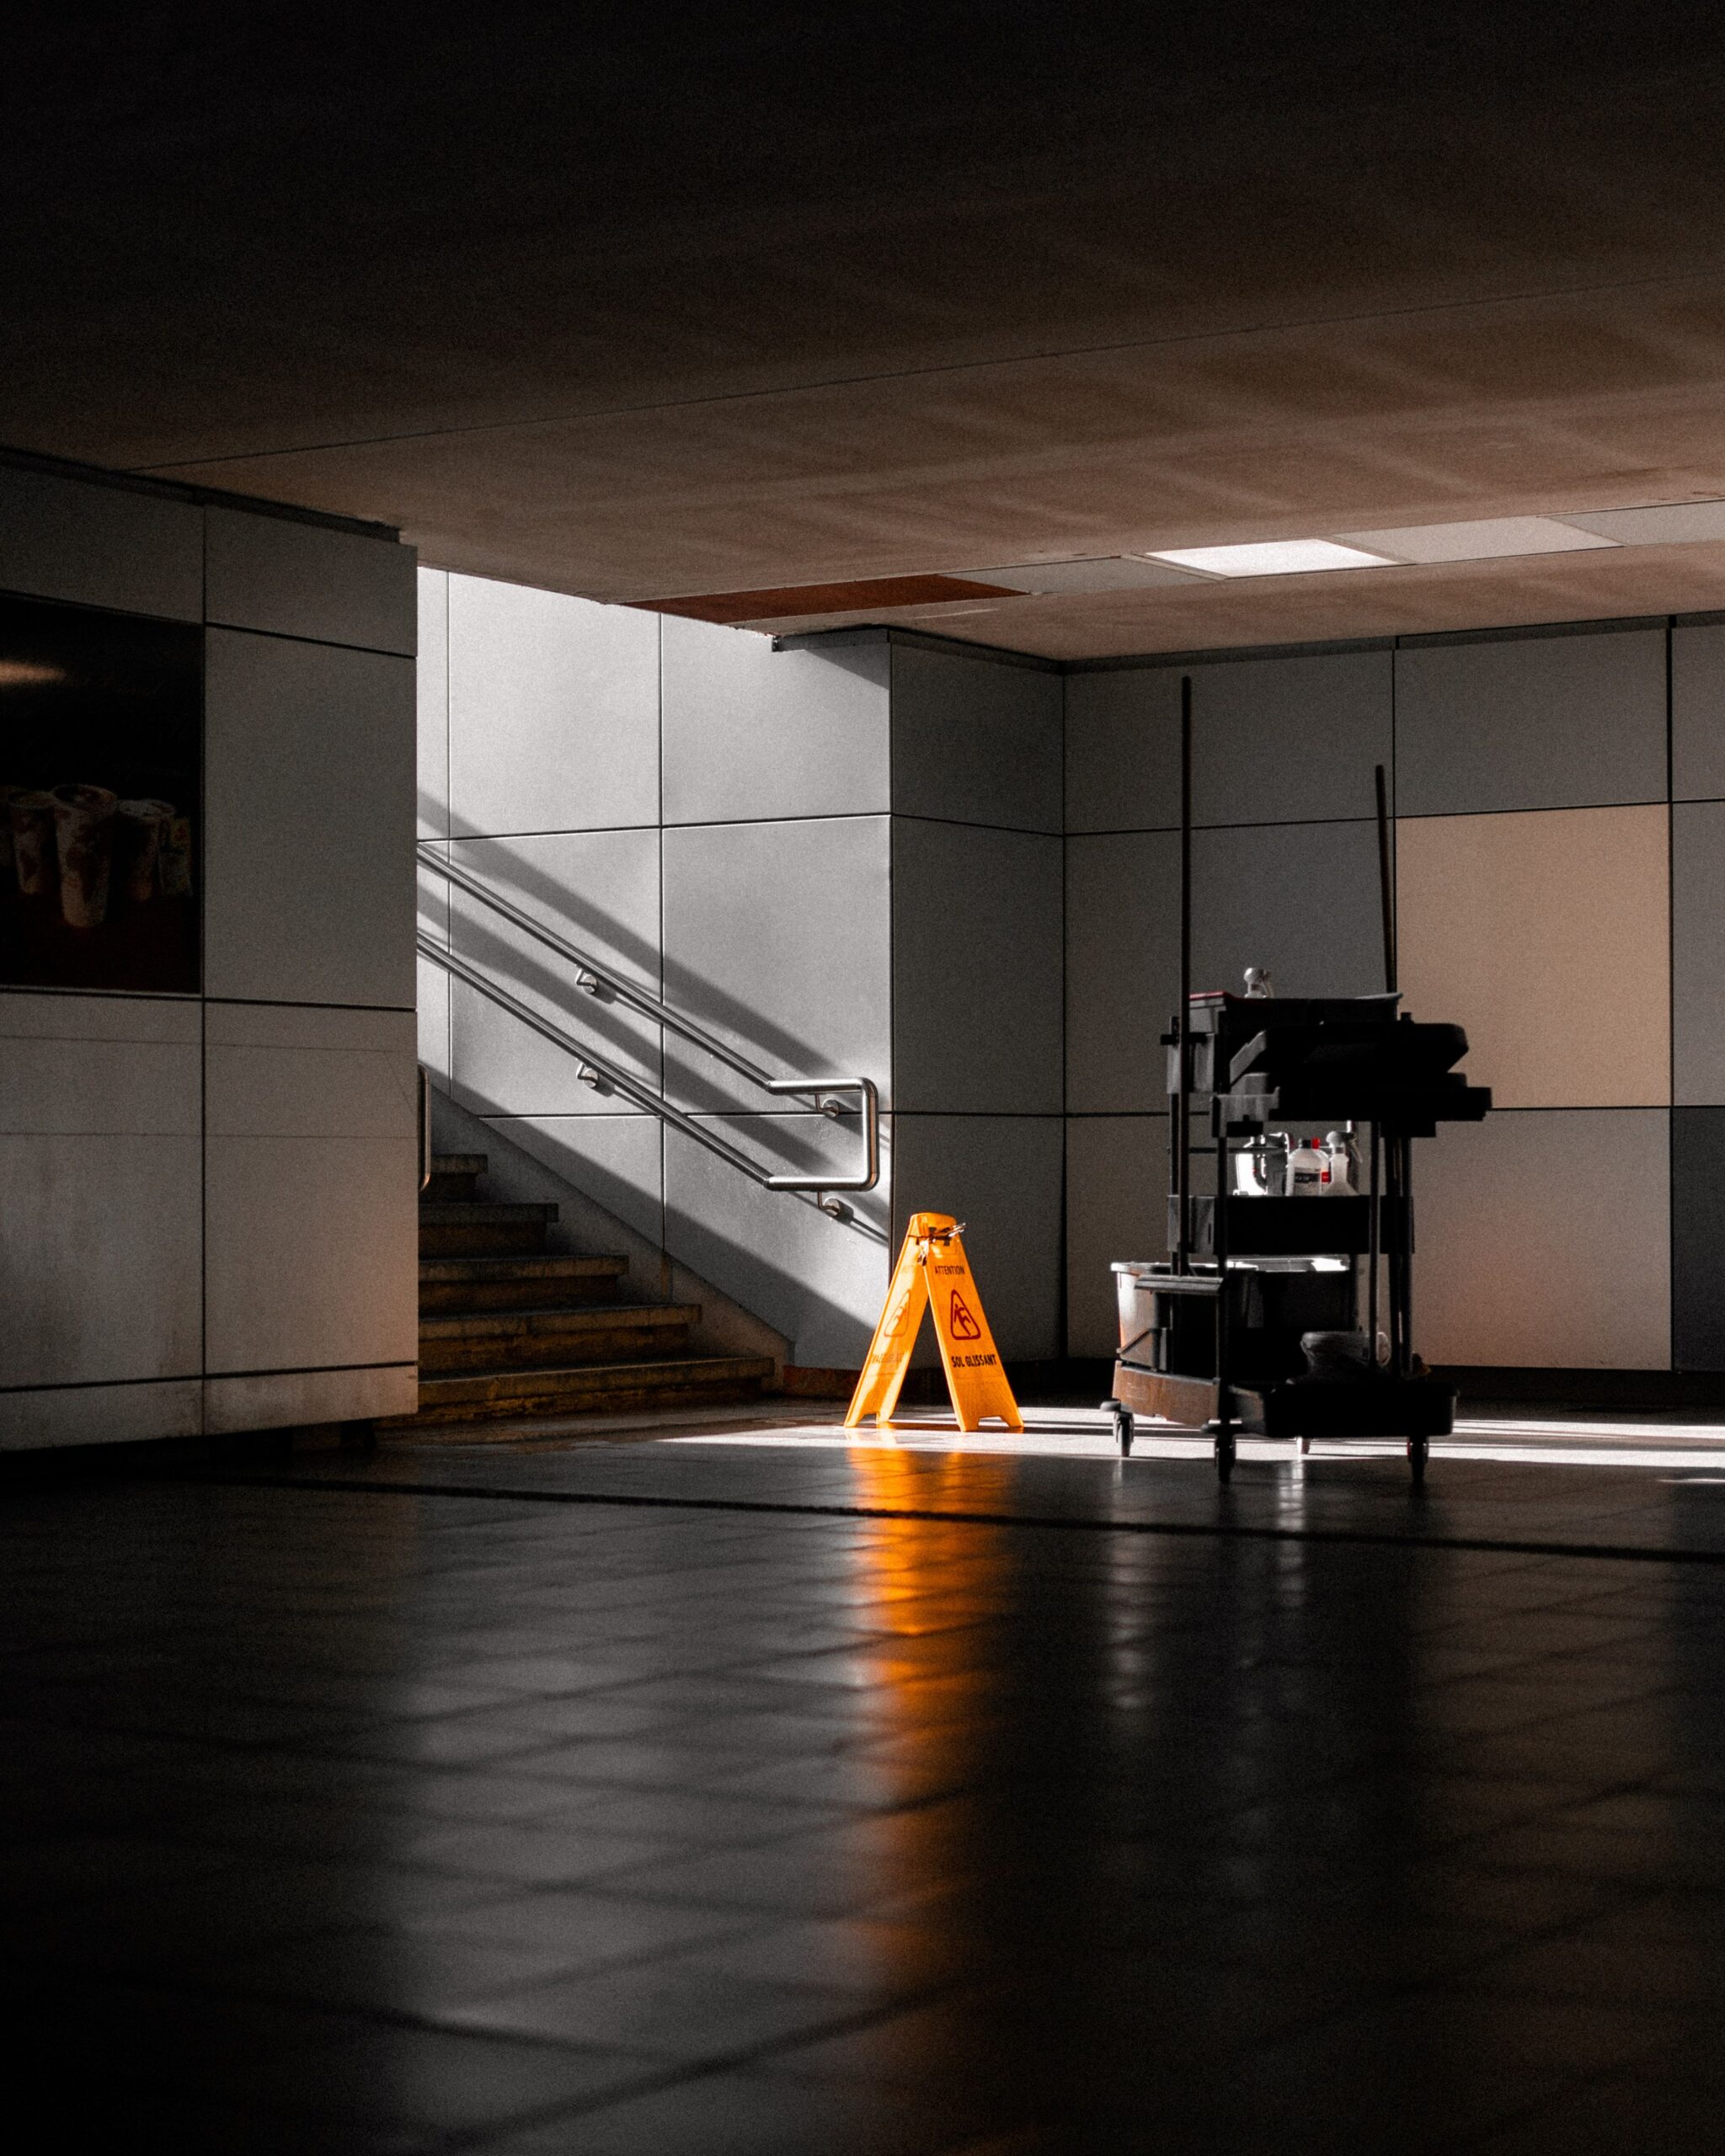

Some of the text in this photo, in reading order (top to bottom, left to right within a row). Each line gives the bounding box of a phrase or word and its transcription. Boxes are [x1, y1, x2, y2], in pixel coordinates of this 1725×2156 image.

[935, 1266, 965, 1275] ATTENTION
[951, 1354, 996, 1368] SOL GLISSANT
